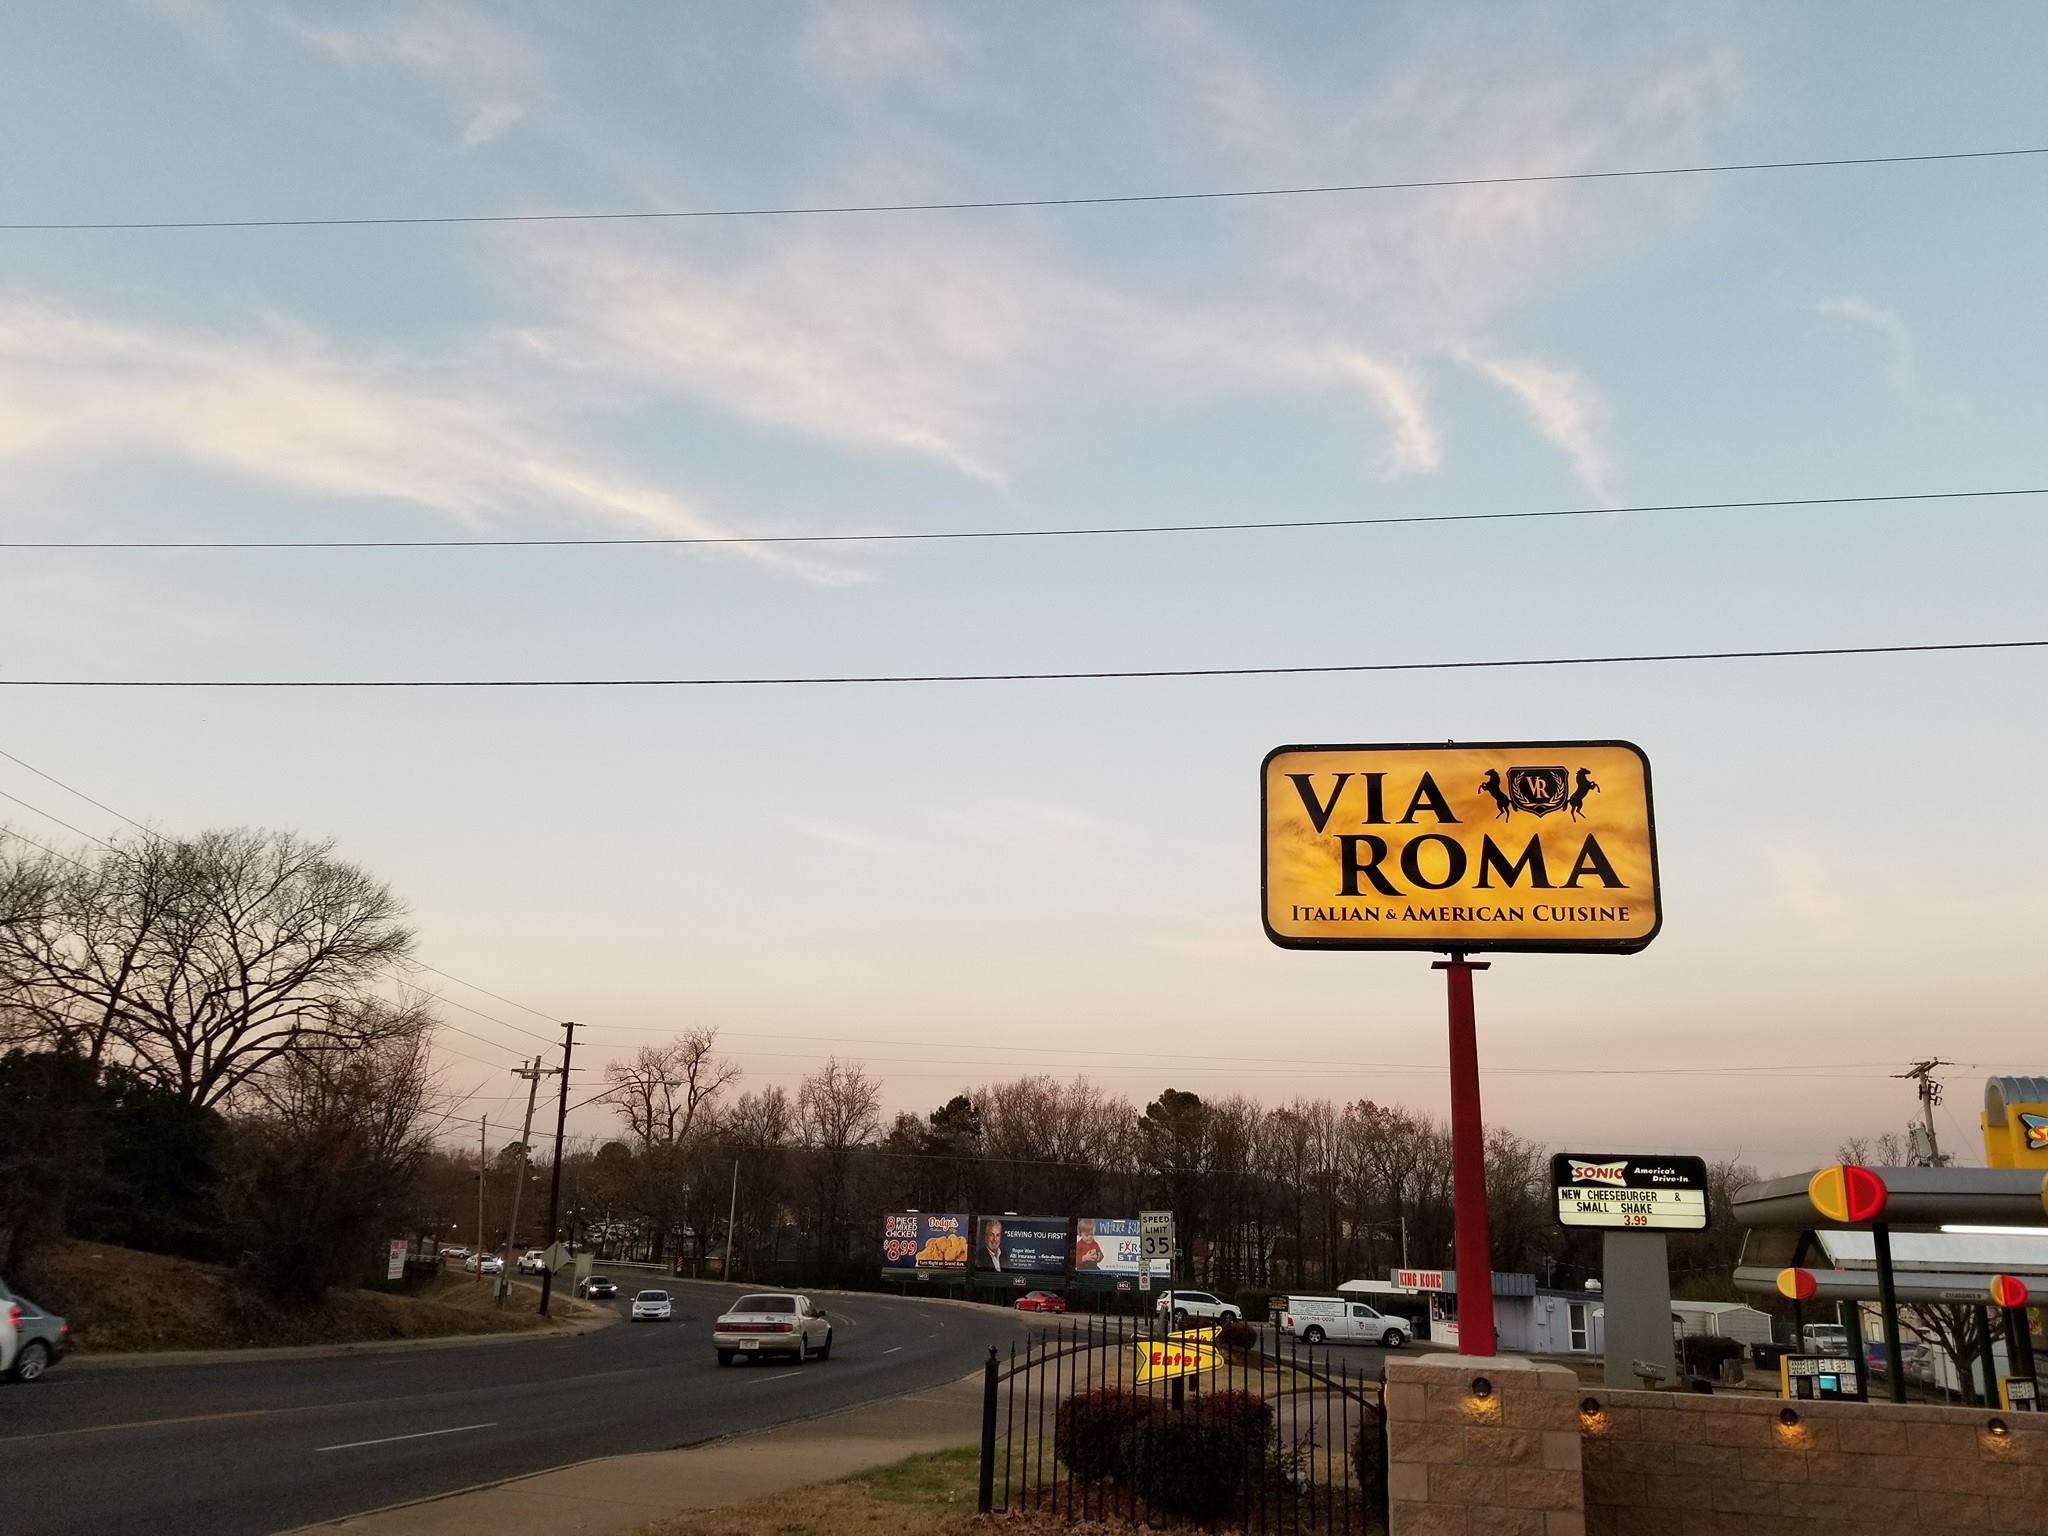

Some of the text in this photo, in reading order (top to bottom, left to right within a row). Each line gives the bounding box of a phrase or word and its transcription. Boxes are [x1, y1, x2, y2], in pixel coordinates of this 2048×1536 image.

[1525, 776, 1550, 798] VR
[1285, 771, 1463, 833] VIA
[1333, 833, 1630, 897] ROMA
[1292, 904, 1630, 921] ITALIAN & AMERICAN CUISINE
[1574, 1167, 1624, 1179] SONIC
[1634, 1167, 1675, 1175] America's
[1561, 1189, 1681, 1201] NEW CHEESEBURGER &
[1577, 1202, 1652, 1213] SMALL SHAKE
[886, 1215, 918, 1231] 8 PIECE
[1624, 1215, 1648, 1226] 3.99
[886, 1230, 917, 1238] CHICKEN
[1033, 1231, 1047, 1239] YOU
[1145, 1237, 1169, 1254] 35
[1399, 1271, 1441, 1288] KING KONE
[1151, 1351, 1202, 1367] Enter
